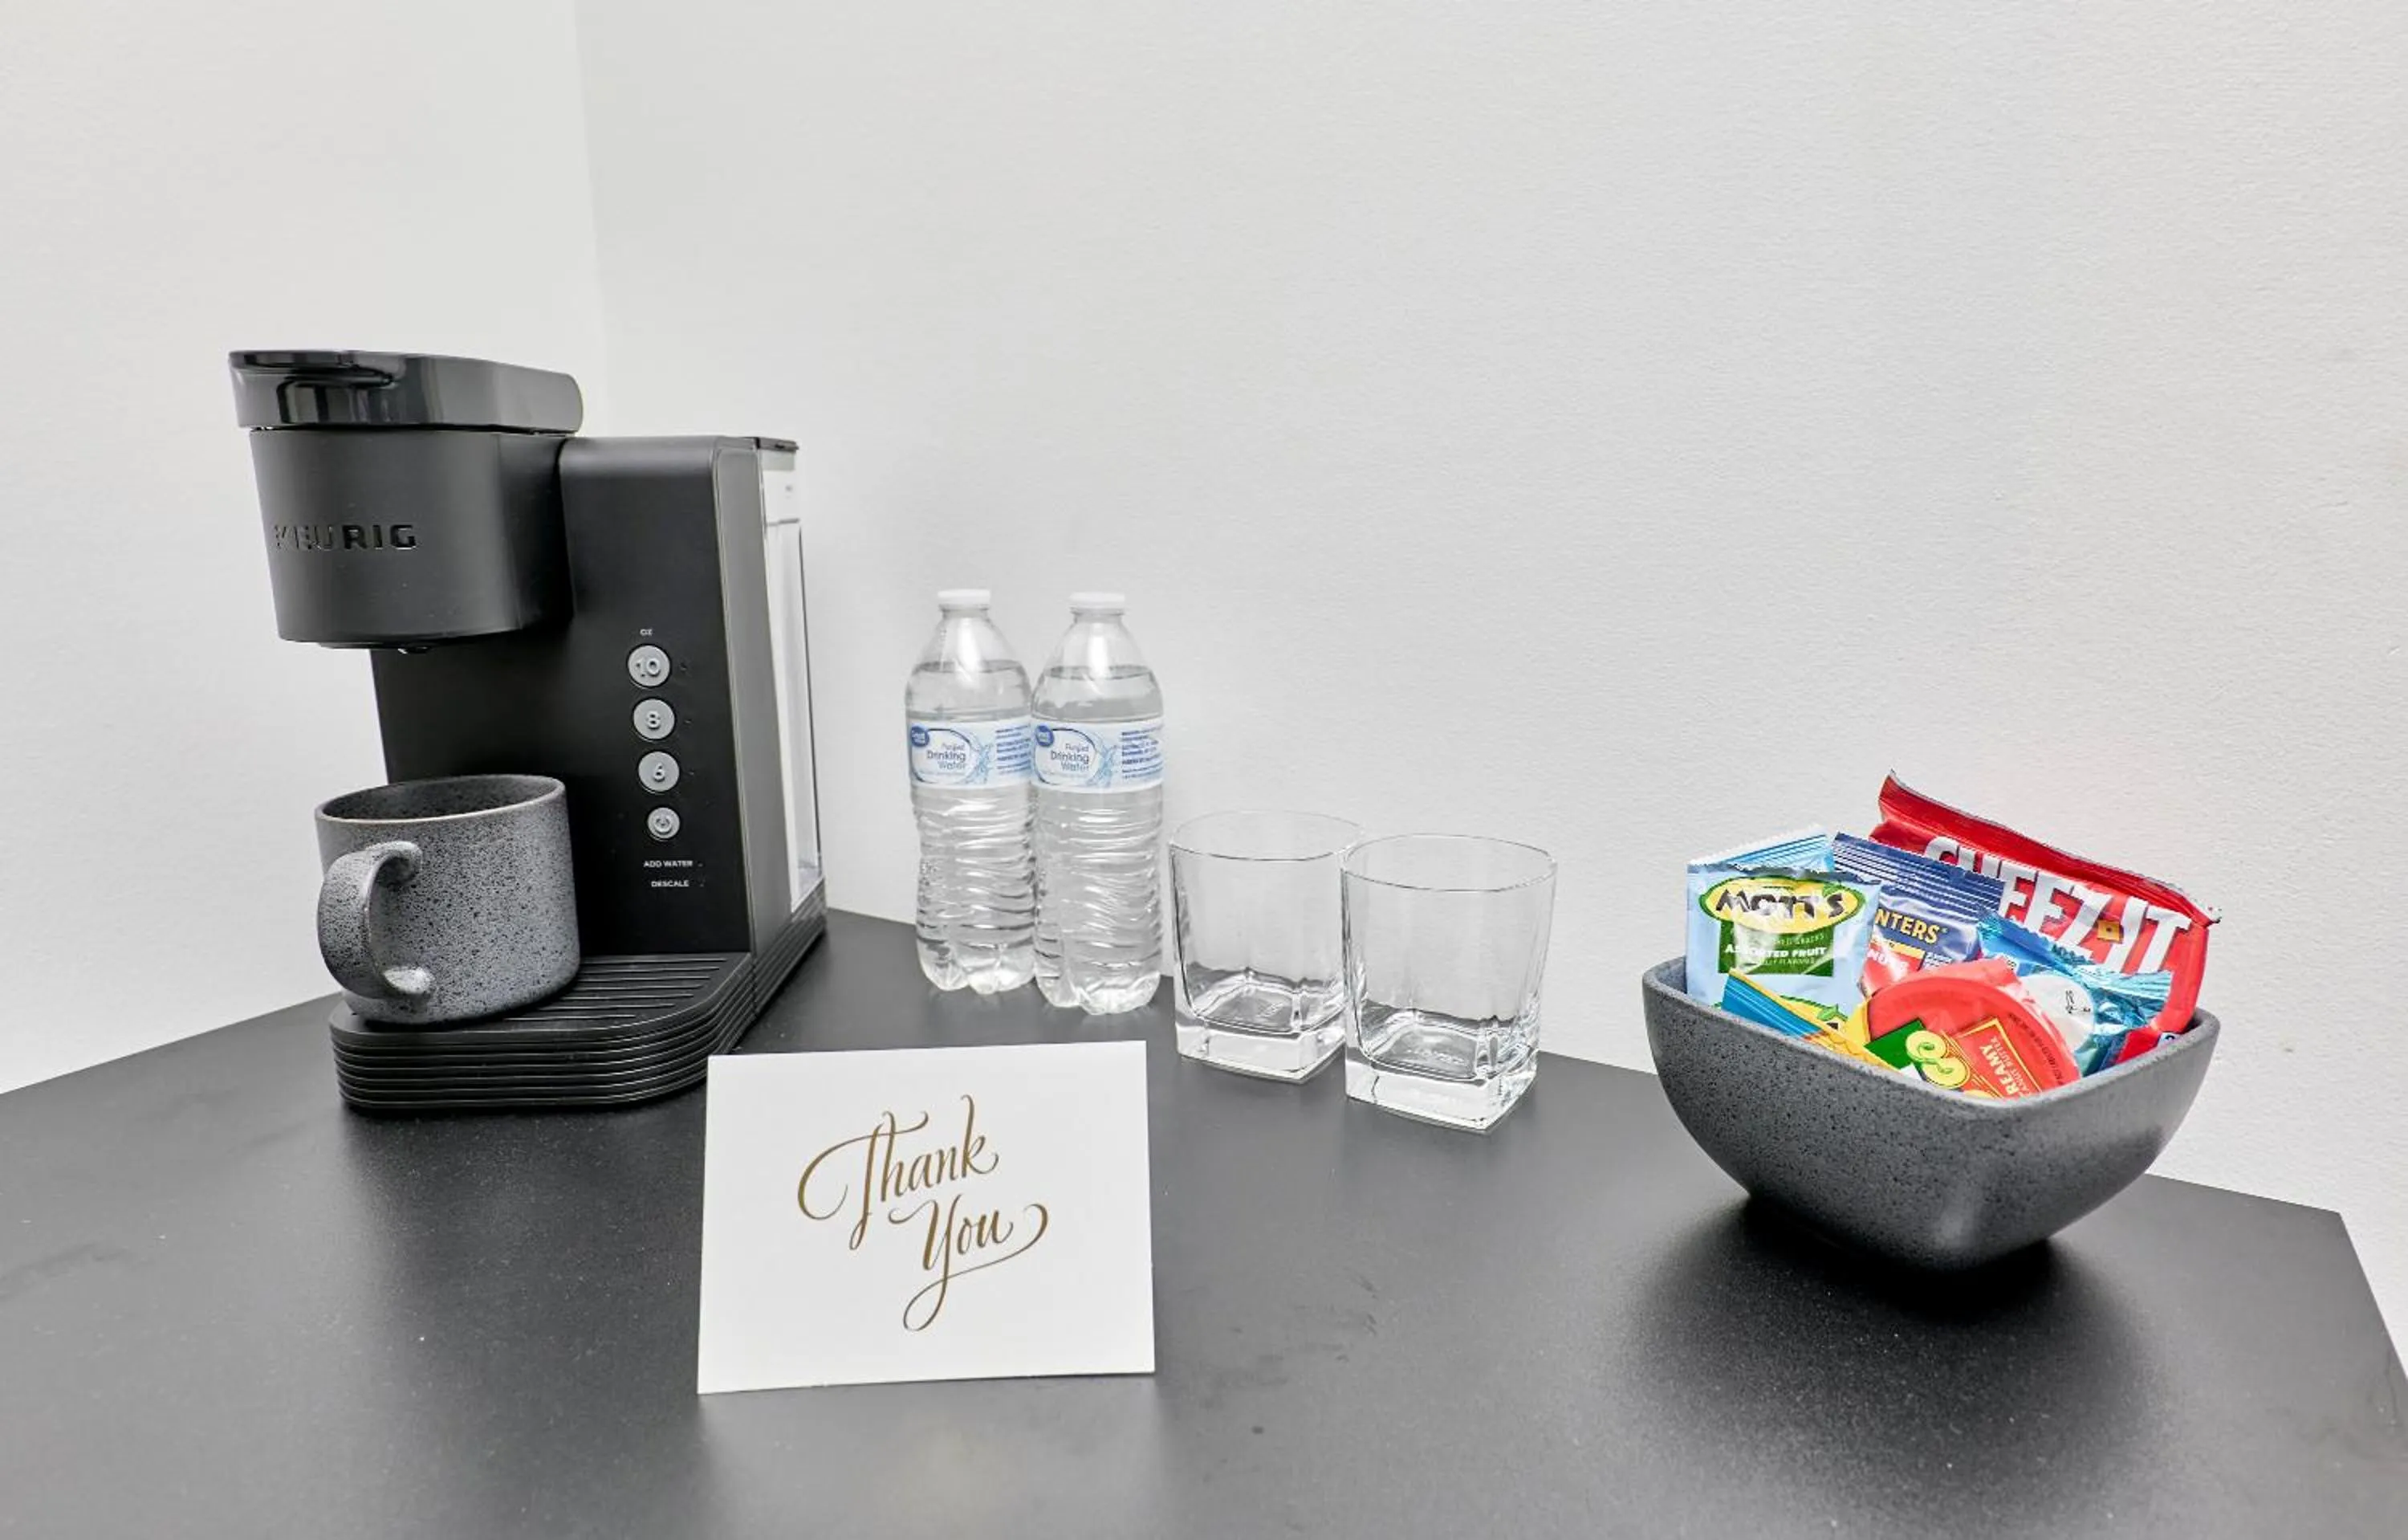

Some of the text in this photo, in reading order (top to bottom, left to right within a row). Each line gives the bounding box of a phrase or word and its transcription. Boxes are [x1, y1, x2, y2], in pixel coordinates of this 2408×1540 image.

[645, 710, 661, 730] 8
[927, 750, 966, 763] Drinking
[1051, 751, 1089, 764] Drinking
[653, 763, 665, 782] 6
[643, 860, 694, 868] ADD WATER
[651, 880, 690, 888] DESCALE
[1874, 908, 1940, 944] NTERS
[1792, 947, 1828, 958] FRUIT
[1979, 1041, 2020, 1097] REAMY
[797, 1094, 999, 1251] Thank
[888, 1192, 1048, 1332] You
